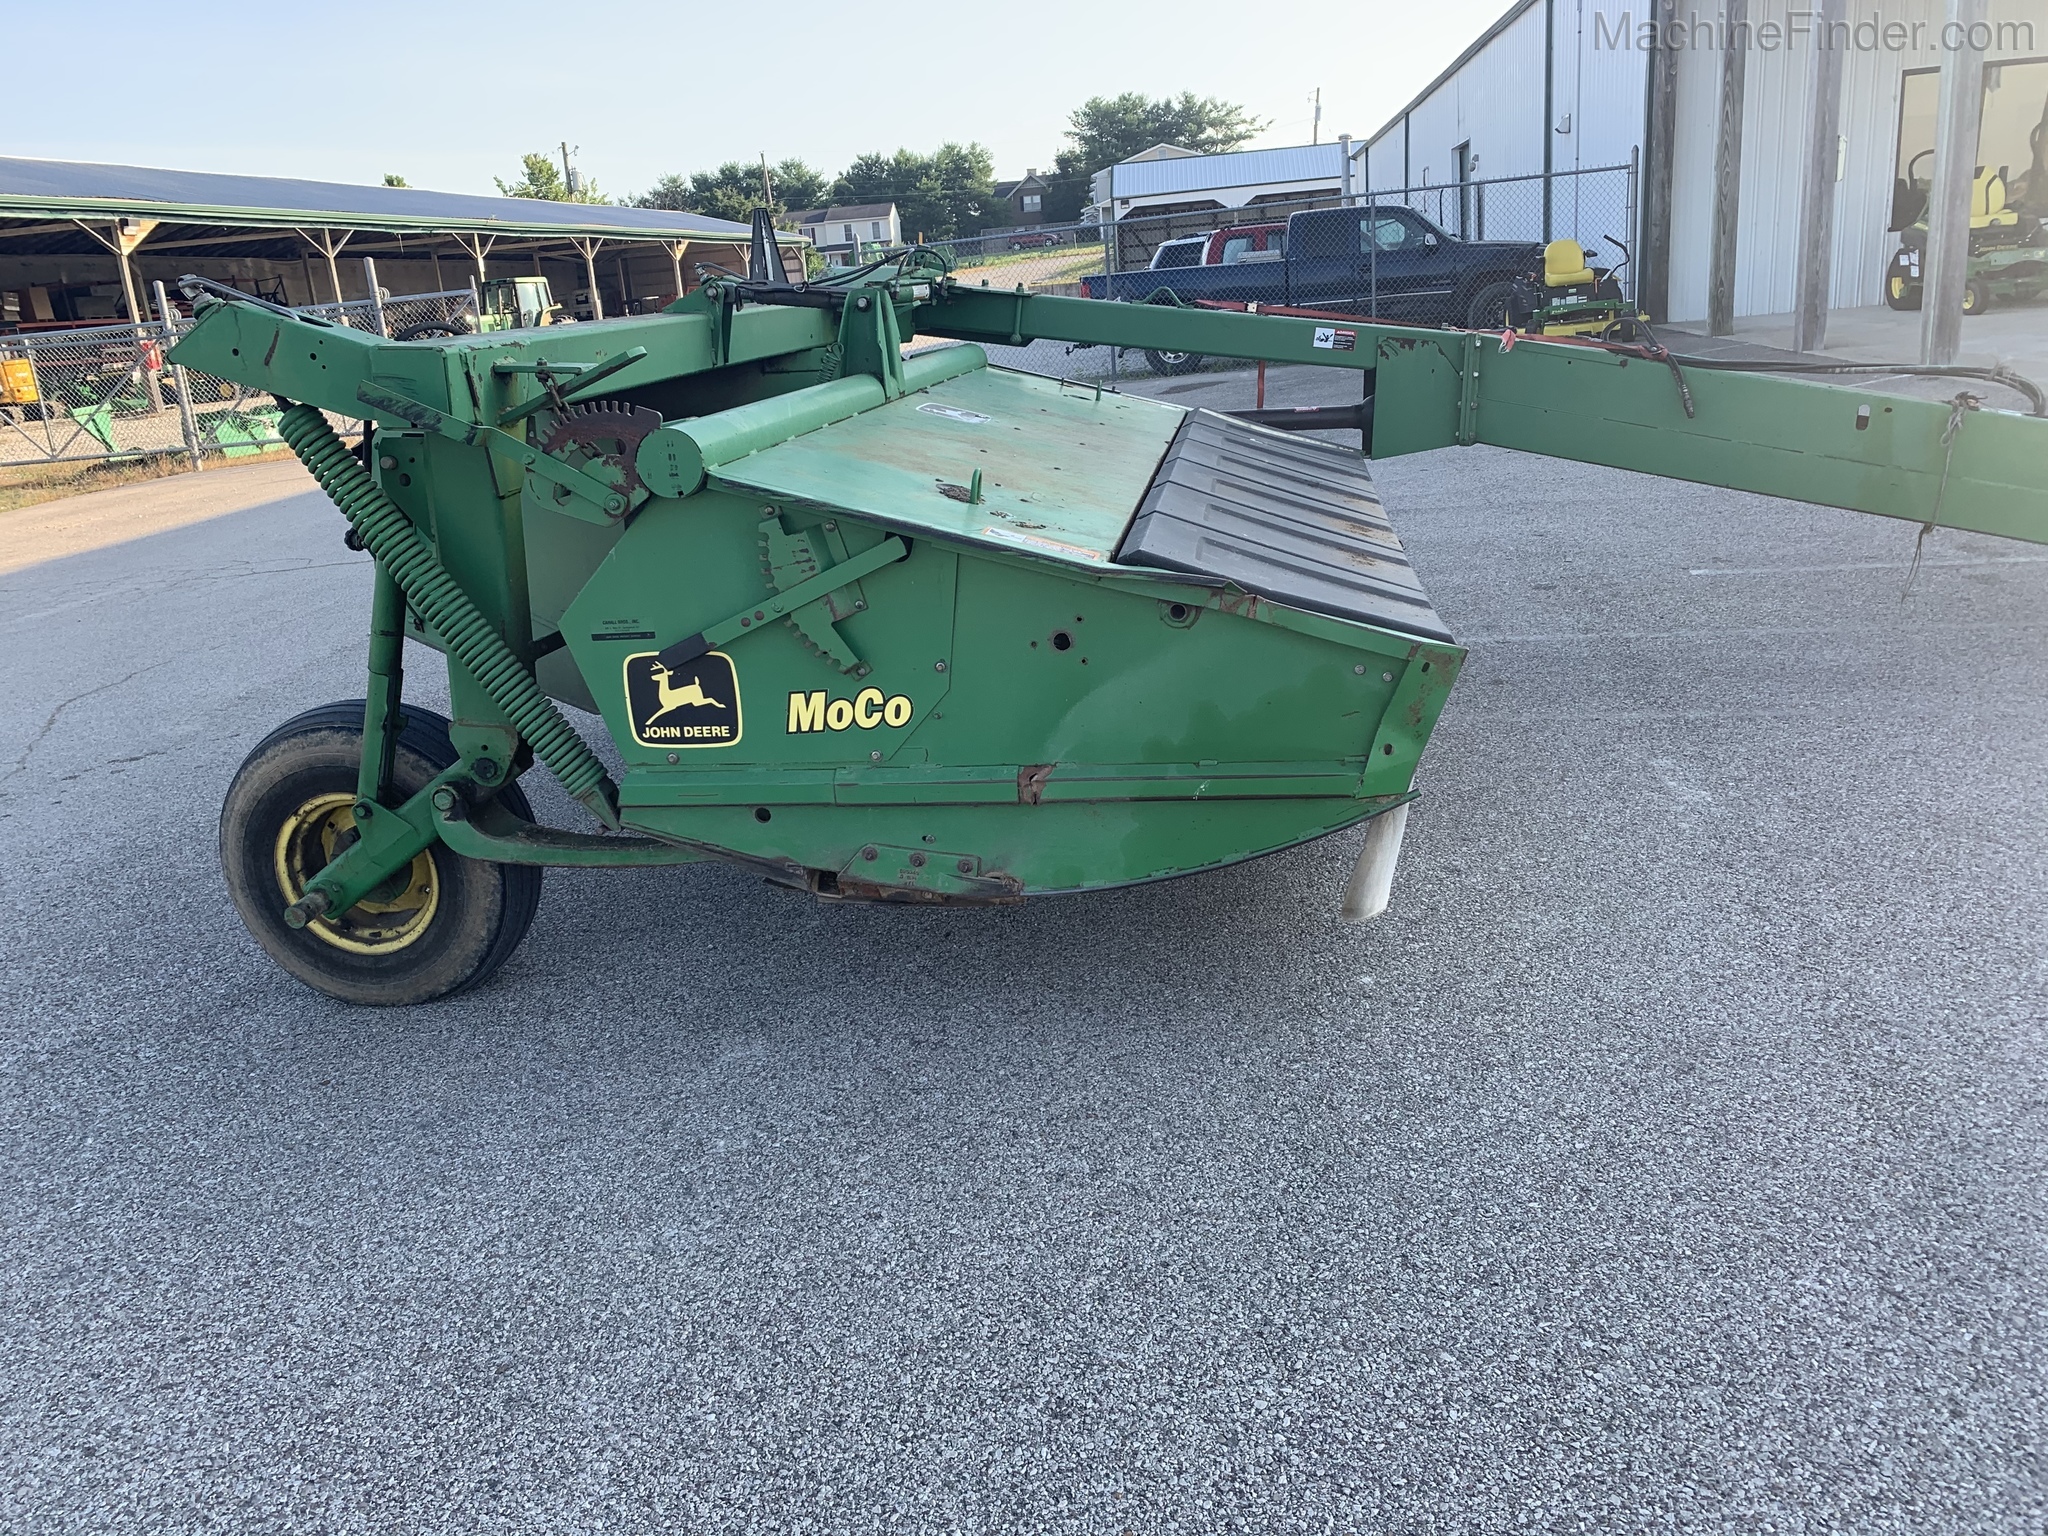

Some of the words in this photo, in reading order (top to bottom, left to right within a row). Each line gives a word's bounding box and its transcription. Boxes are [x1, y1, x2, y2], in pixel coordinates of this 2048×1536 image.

[787, 686, 913, 734] MoCo
[642, 726, 681, 738] JOHN
[683, 726, 731, 737] DEERE
